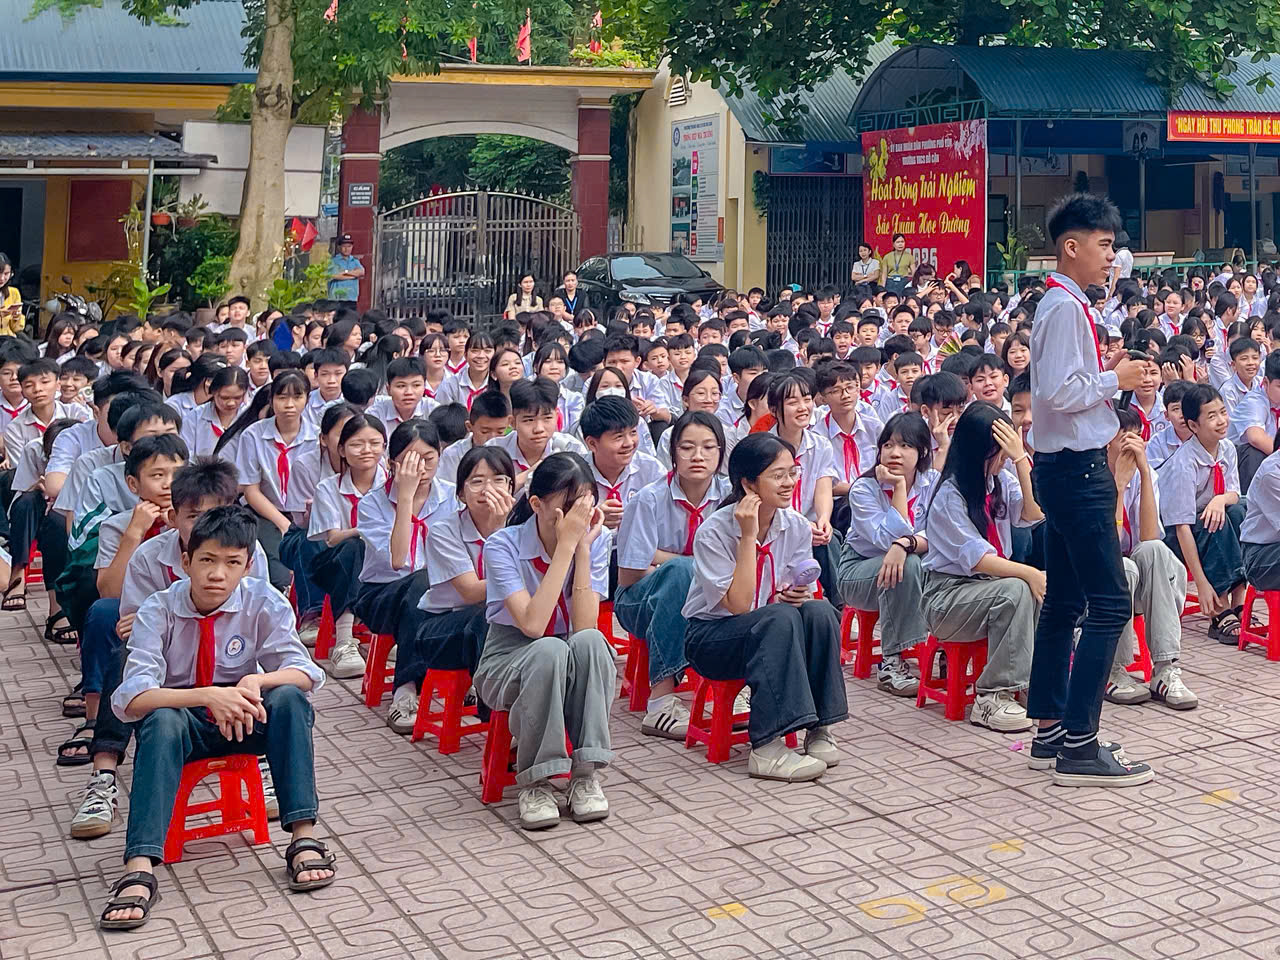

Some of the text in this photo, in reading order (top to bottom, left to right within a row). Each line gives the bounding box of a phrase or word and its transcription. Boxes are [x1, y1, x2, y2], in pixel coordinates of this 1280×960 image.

[1197, 115, 1208, 136] HỘI
[1223, 118, 1244, 134] PHONG
[1246, 116, 1262, 135] TRÀO
[1262, 115, 1271, 135] KẾ
[871, 170, 976, 208] Hoạt Động Trải Nghiệm
[939, 211, 970, 238] Đường
